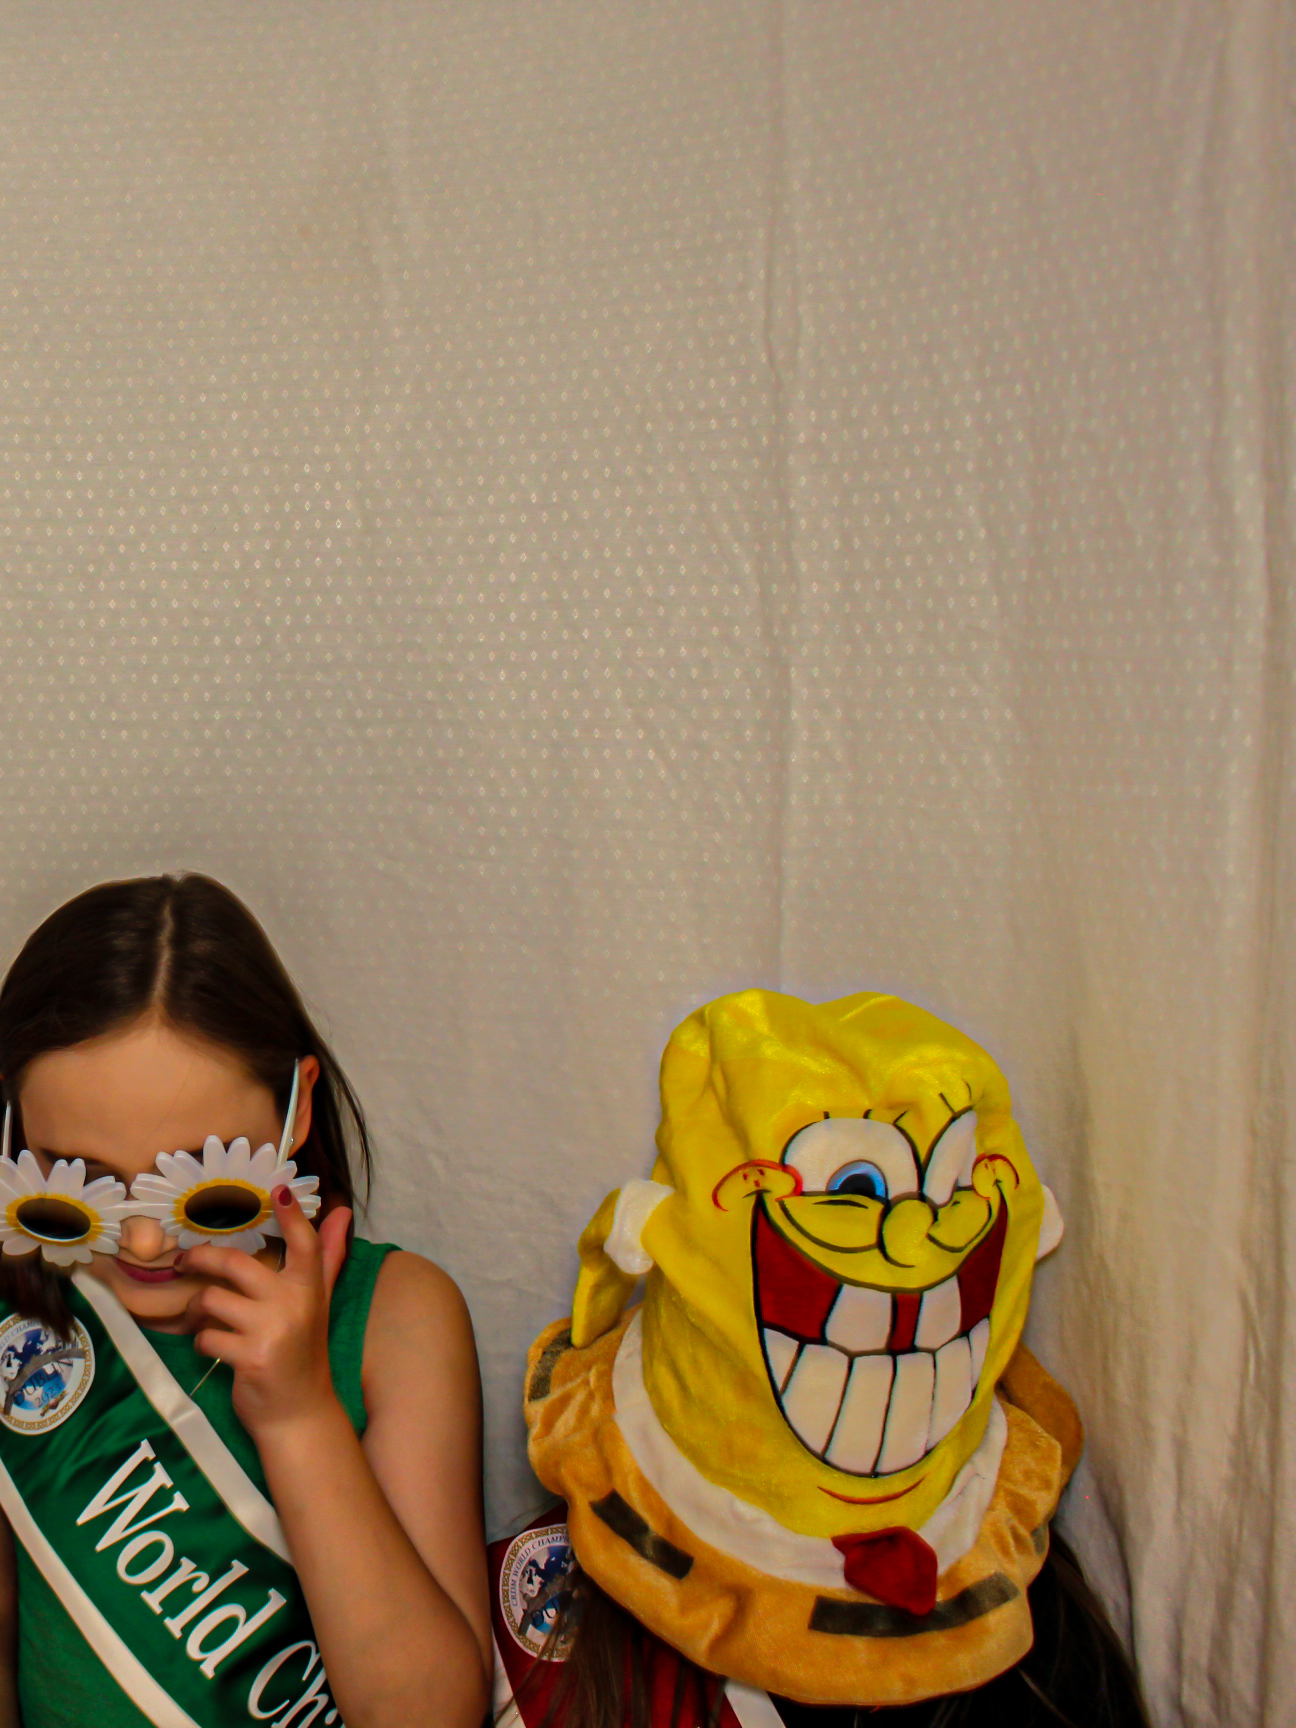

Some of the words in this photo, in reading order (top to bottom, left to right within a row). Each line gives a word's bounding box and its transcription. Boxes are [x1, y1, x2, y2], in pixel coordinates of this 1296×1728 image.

[35, 1383, 62, 1408] 2023
[512, 1547, 532, 1578] WORLD
[75, 1437, 288, 1680] World
[247, 1640, 346, 1728] Ch
[509, 1579, 518, 1607] CRDM
